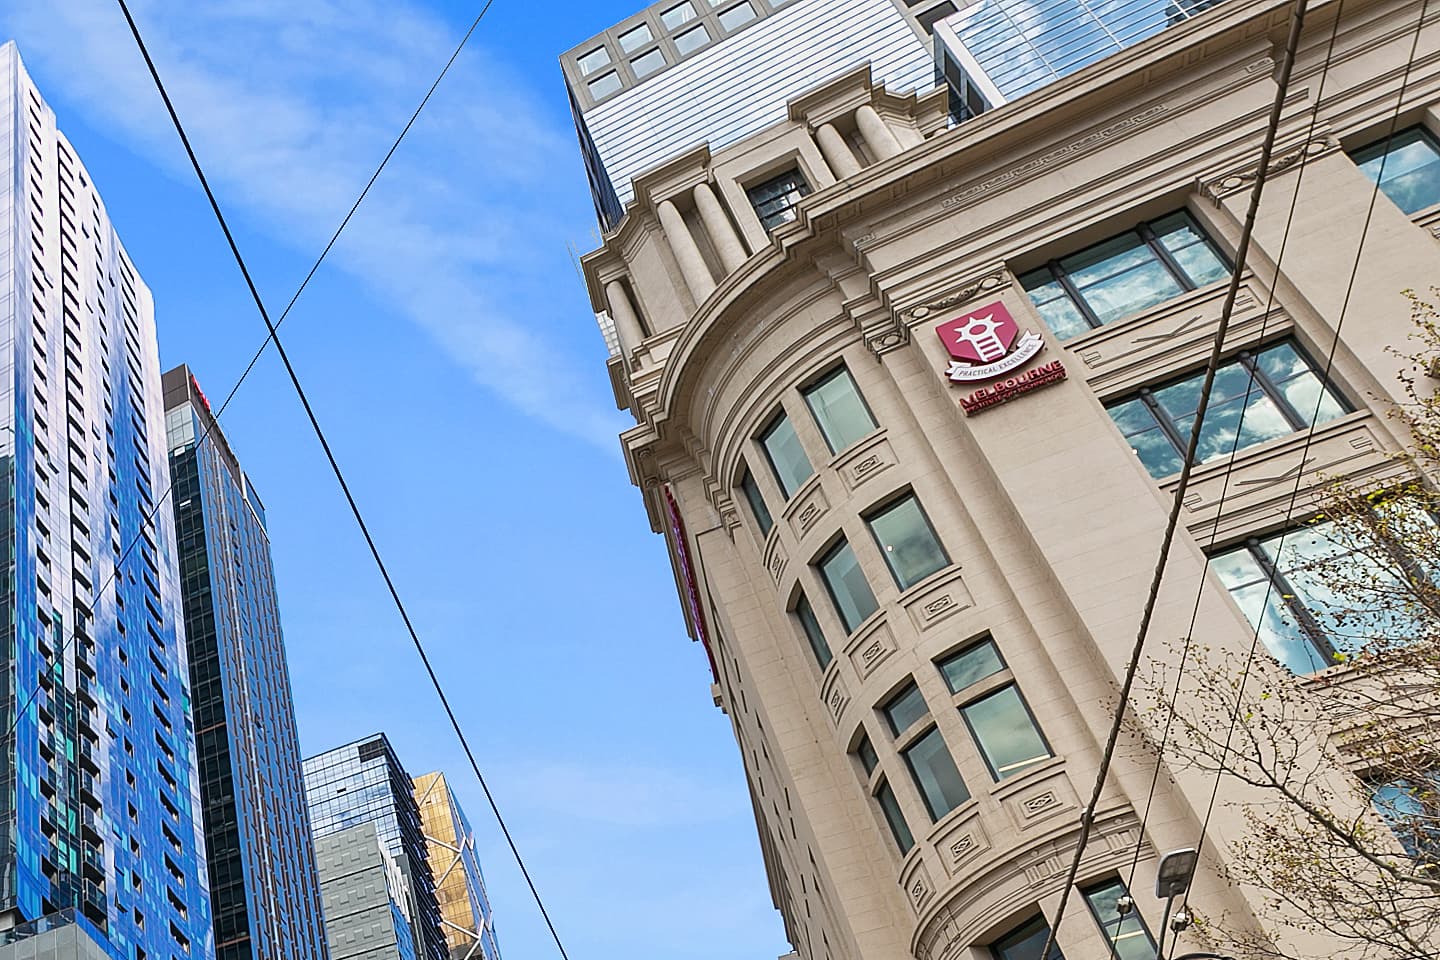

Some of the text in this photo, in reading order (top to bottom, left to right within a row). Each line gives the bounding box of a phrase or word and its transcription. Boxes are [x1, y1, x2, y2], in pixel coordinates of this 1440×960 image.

[958, 343, 1037, 377] PRACTICAL EXCELLENCE
[959, 360, 1064, 408] MELBOURNE
